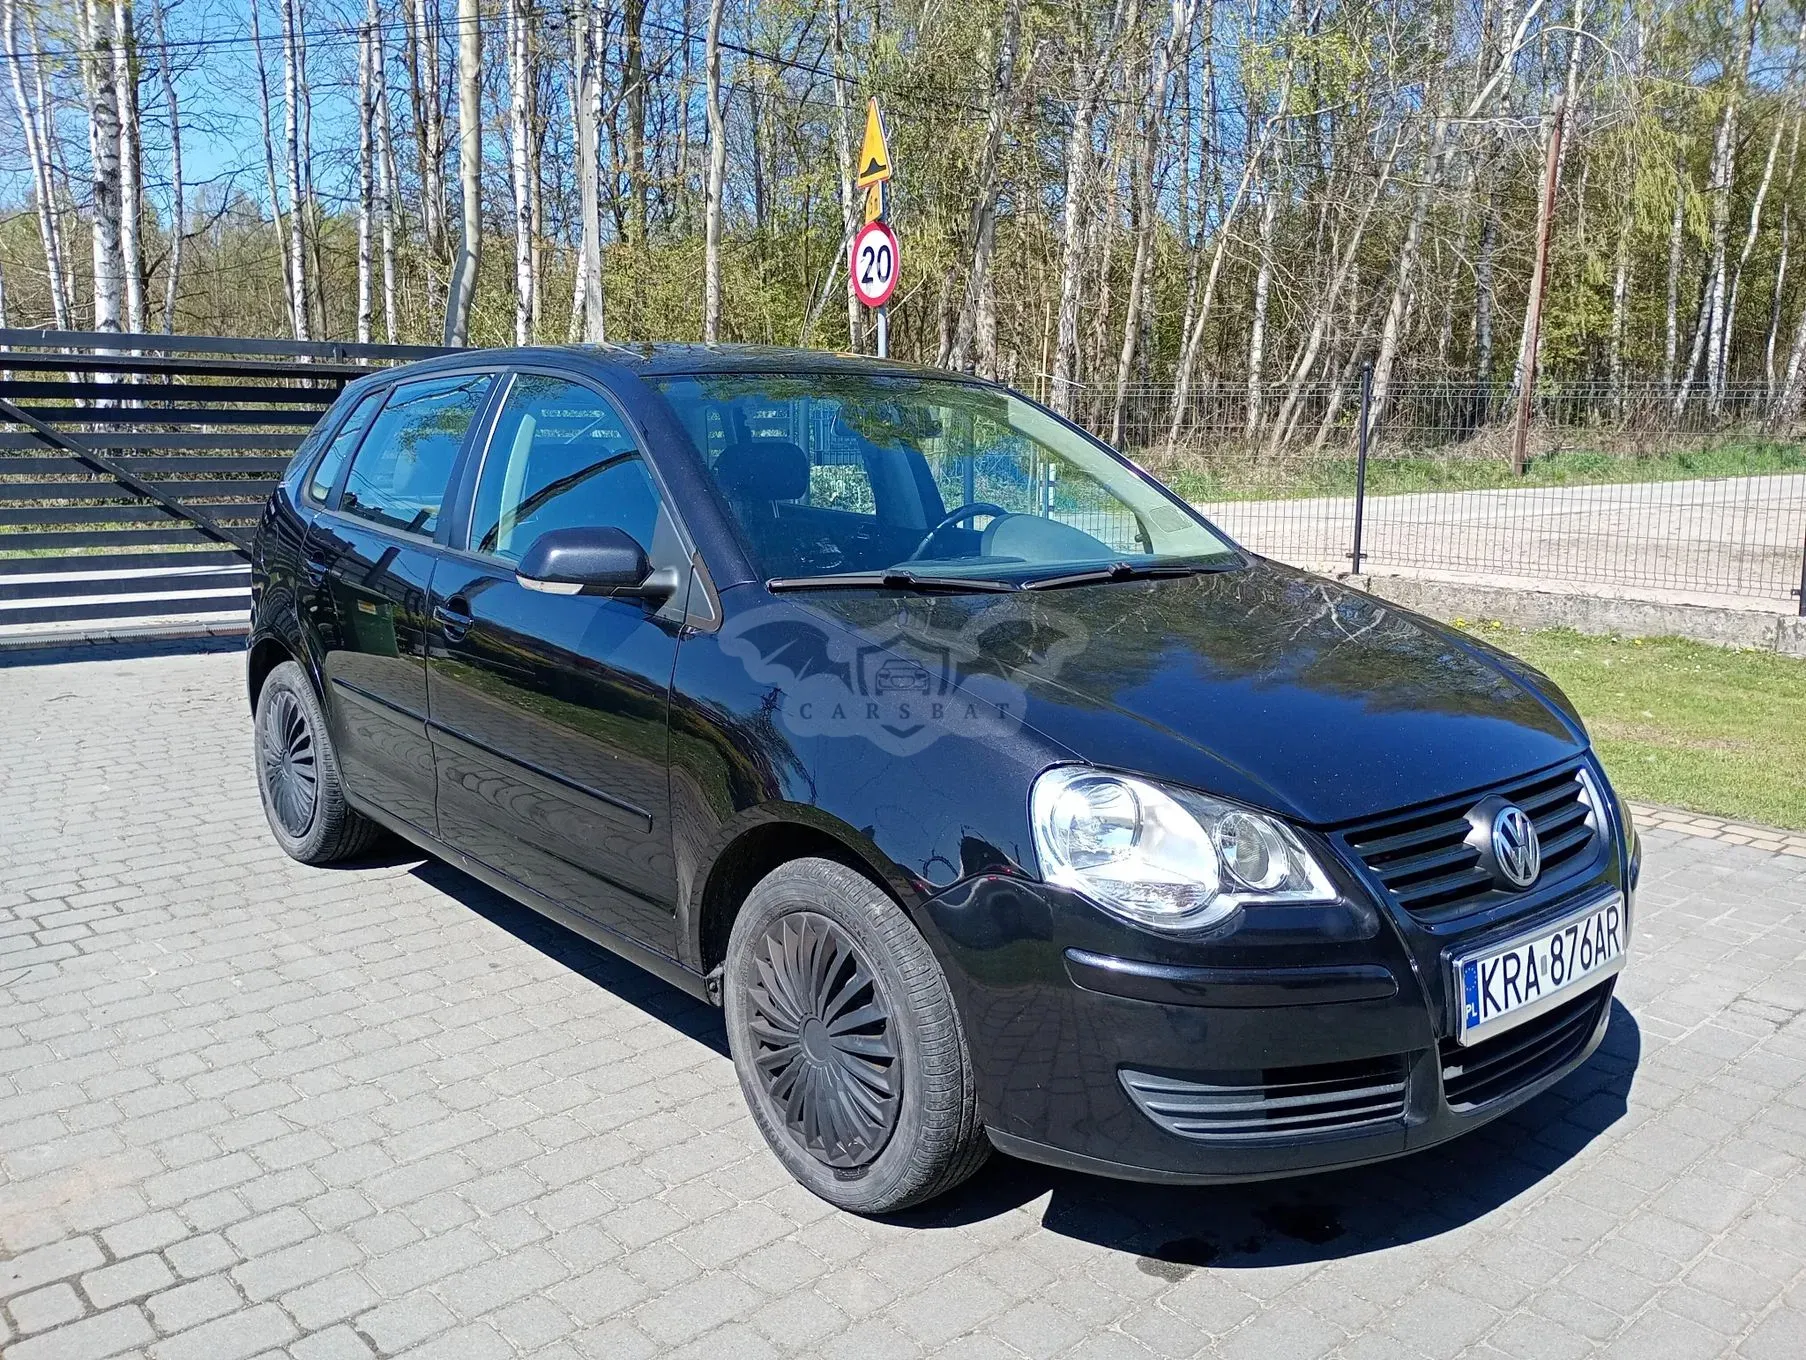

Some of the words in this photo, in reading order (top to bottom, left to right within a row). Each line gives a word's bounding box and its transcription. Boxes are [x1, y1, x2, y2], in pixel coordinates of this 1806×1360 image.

[861, 244, 892, 284] 20
[1481, 944, 1541, 1018] KRA
[1550, 905, 1620, 986] 876AR
[1466, 1002, 1478, 1019] PL
